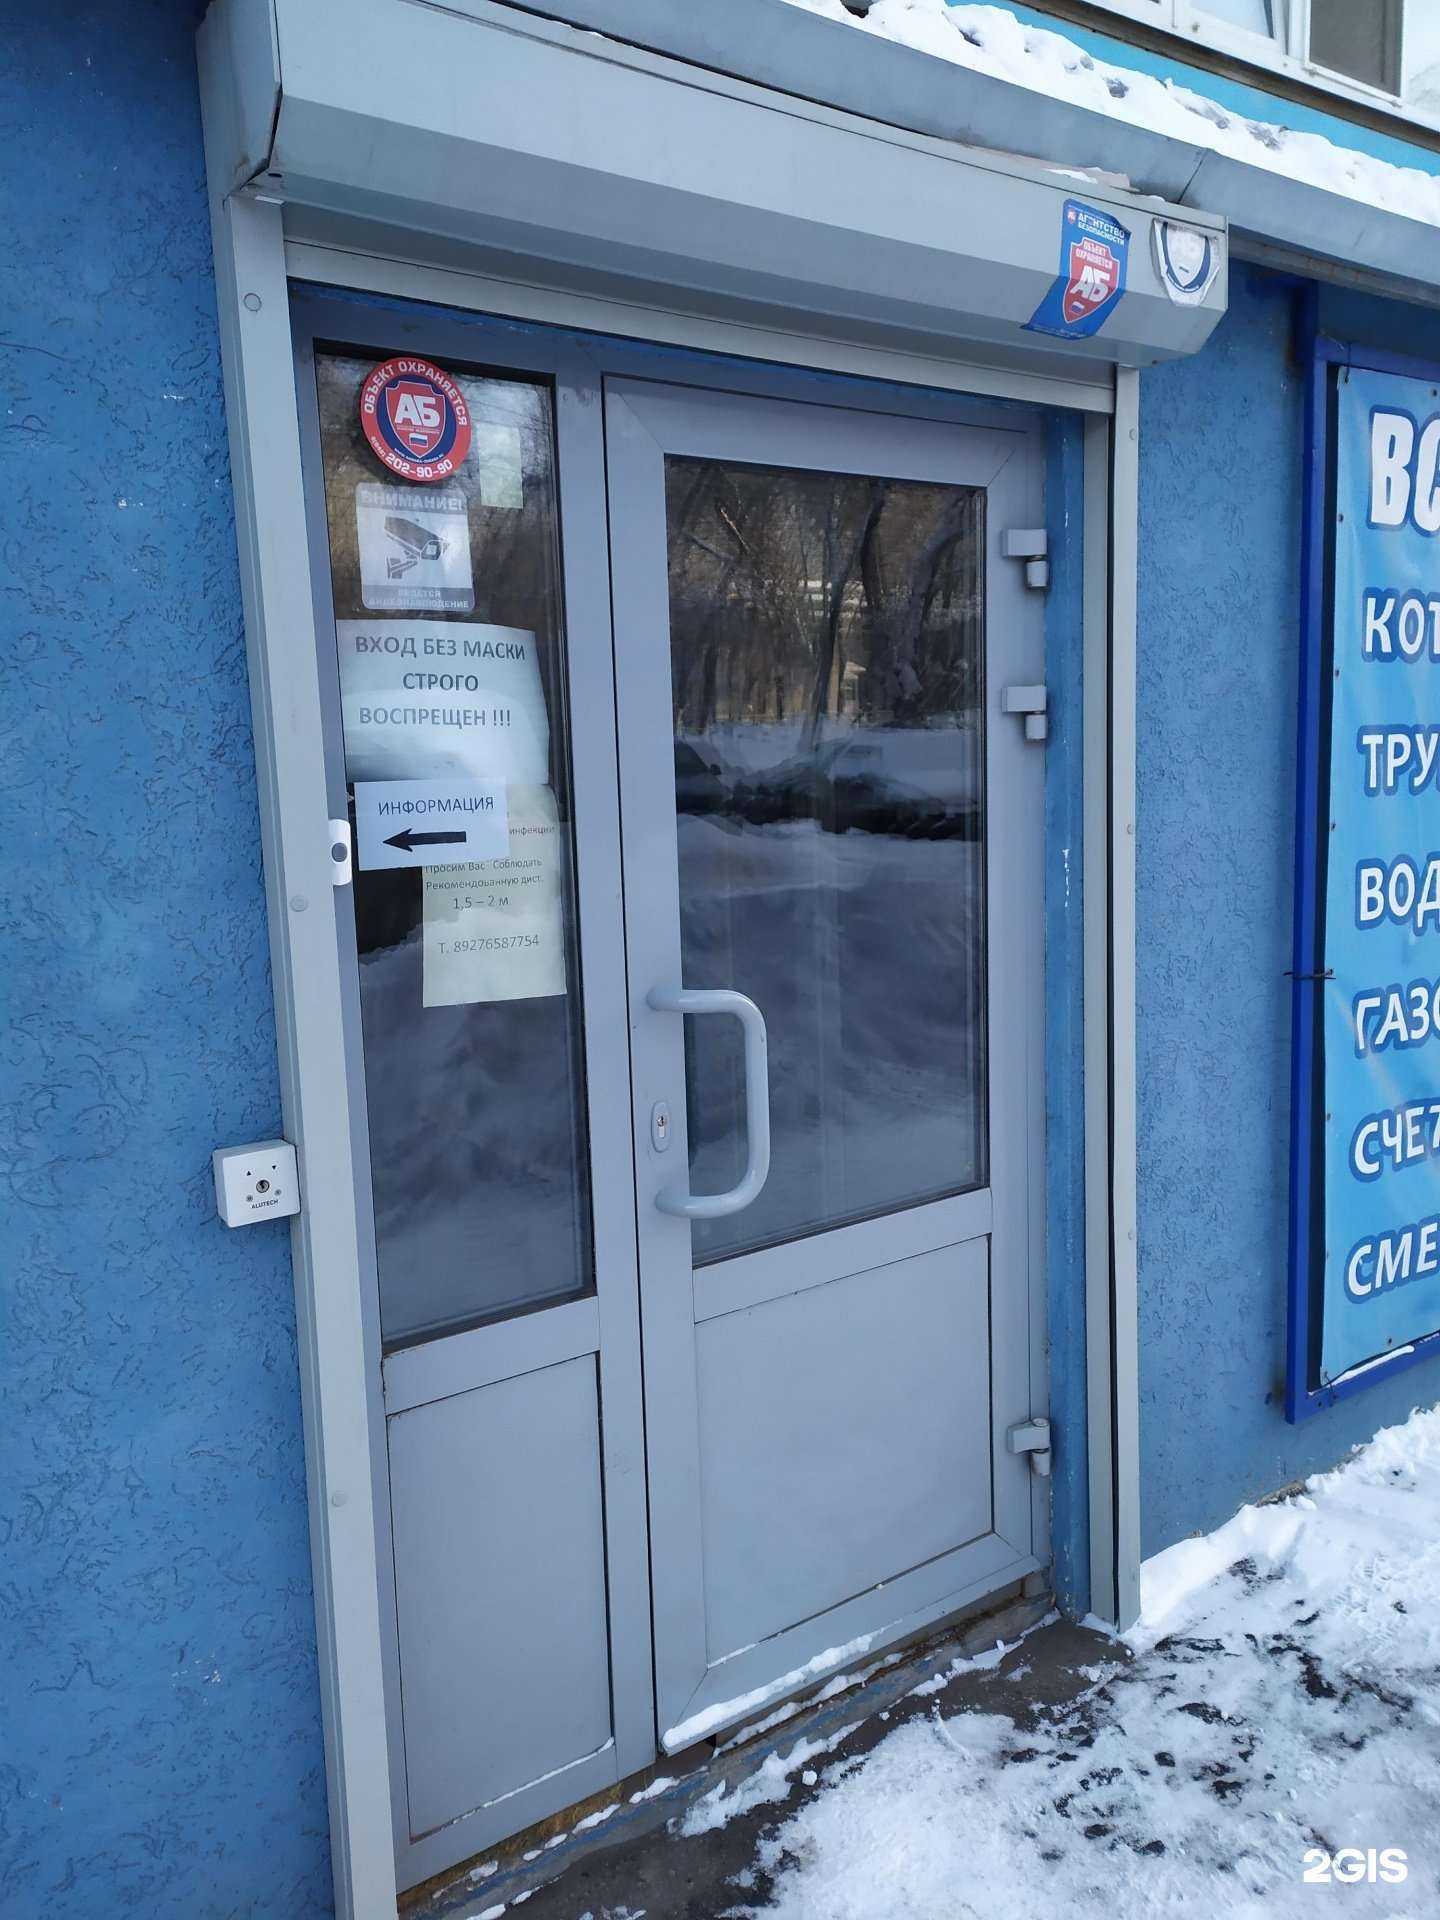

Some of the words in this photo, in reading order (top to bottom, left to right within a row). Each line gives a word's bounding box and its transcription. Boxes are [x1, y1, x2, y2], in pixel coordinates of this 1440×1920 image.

[1071, 265, 1110, 302] АБ
[364, 365, 395, 414] ОБЪЕКТ
[398, 361, 468, 426] ОХРАНЯЕТСЯ
[395, 393, 440, 428] АБ
[385, 452, 453, 478] 202-90-90
[355, 636, 417, 658] ВХОД
[423, 638, 457, 657] БЕЗ
[463, 640, 526, 661] МАСКИ
[402, 673, 479, 692] СТРОГО
[359, 707, 487, 729] ВОСПРЕЩЕН
[493, 709, 511, 727] !!!
[378, 796, 495, 816] ИНФОРМАЦИЯ
[425, 864, 466, 875] Просим
[493, 858, 543, 870] Соблюдать
[426, 876, 519, 891] Рекомендованную
[453, 896, 472, 911] 1,5
[487, 895, 496, 907] 2
[453, 934, 540, 954] 89276587754
[251, 1199, 279, 1209] ALUTECH
